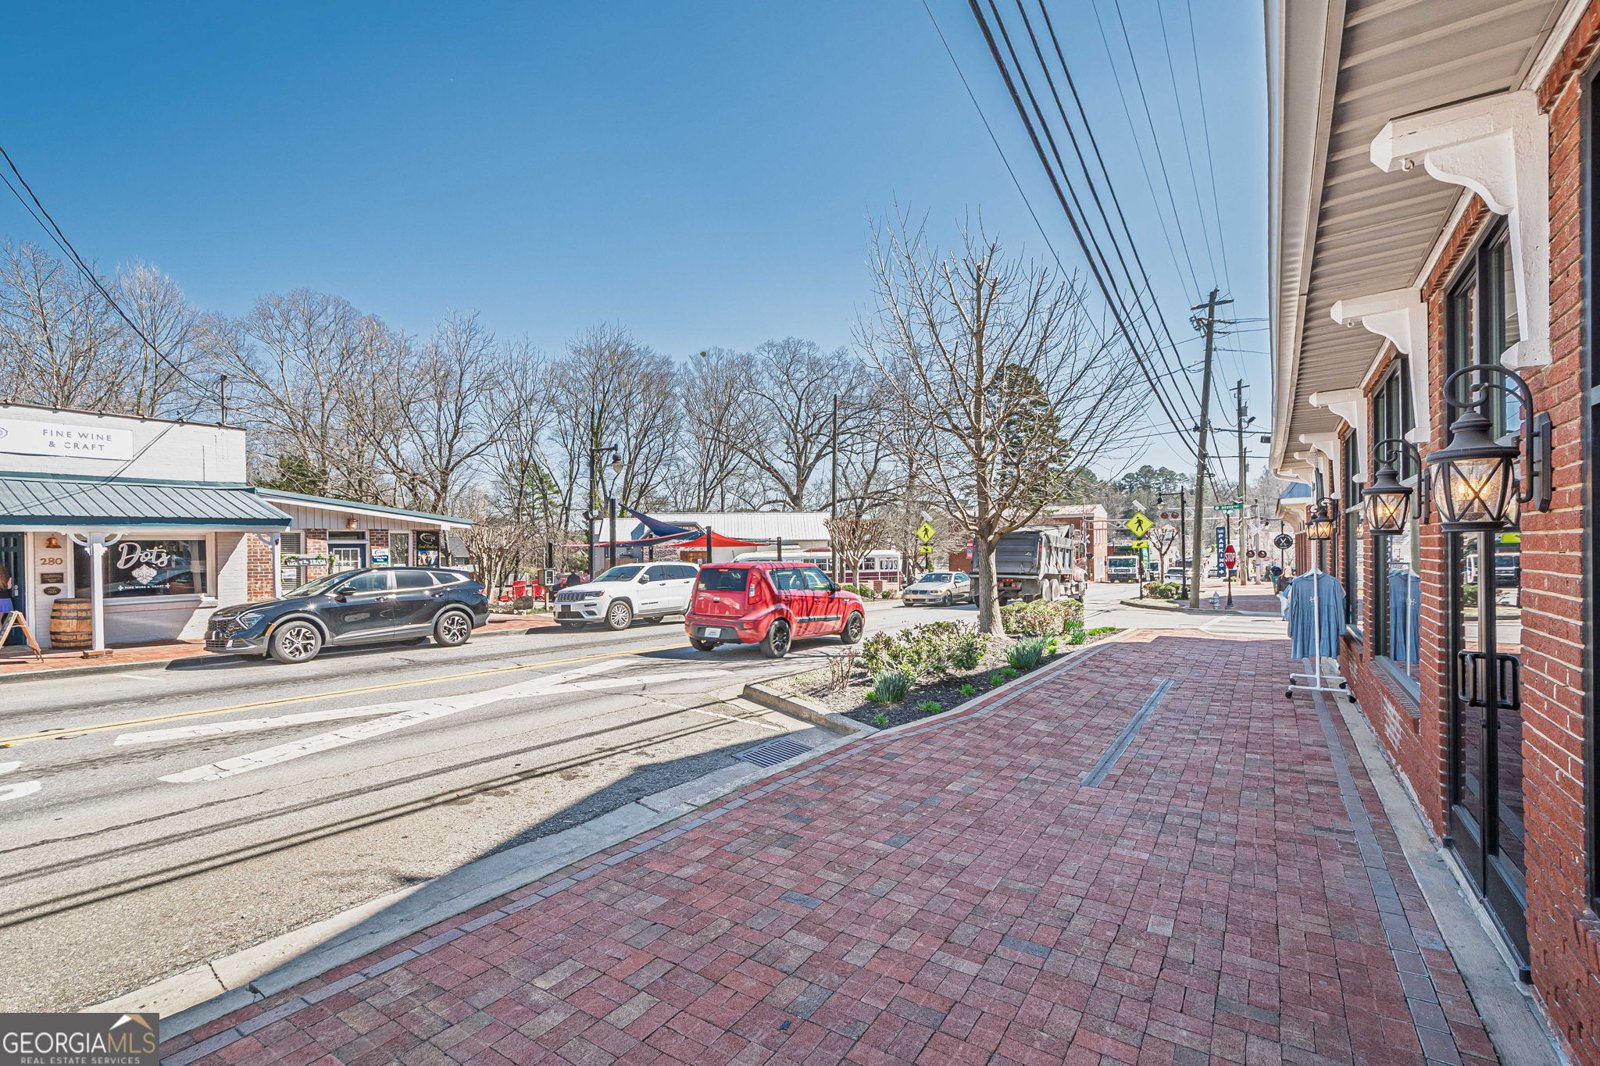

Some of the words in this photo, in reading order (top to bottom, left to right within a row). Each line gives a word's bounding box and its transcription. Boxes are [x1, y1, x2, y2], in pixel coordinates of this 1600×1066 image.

[42, 429, 72, 438] FINE
[78, 432, 112, 441] WINE
[48, 440, 56, 448] &
[64, 441, 104, 451] CRAFT
[40, 557, 63, 566] 280
[1224, 552, 1236, 562] STOP
